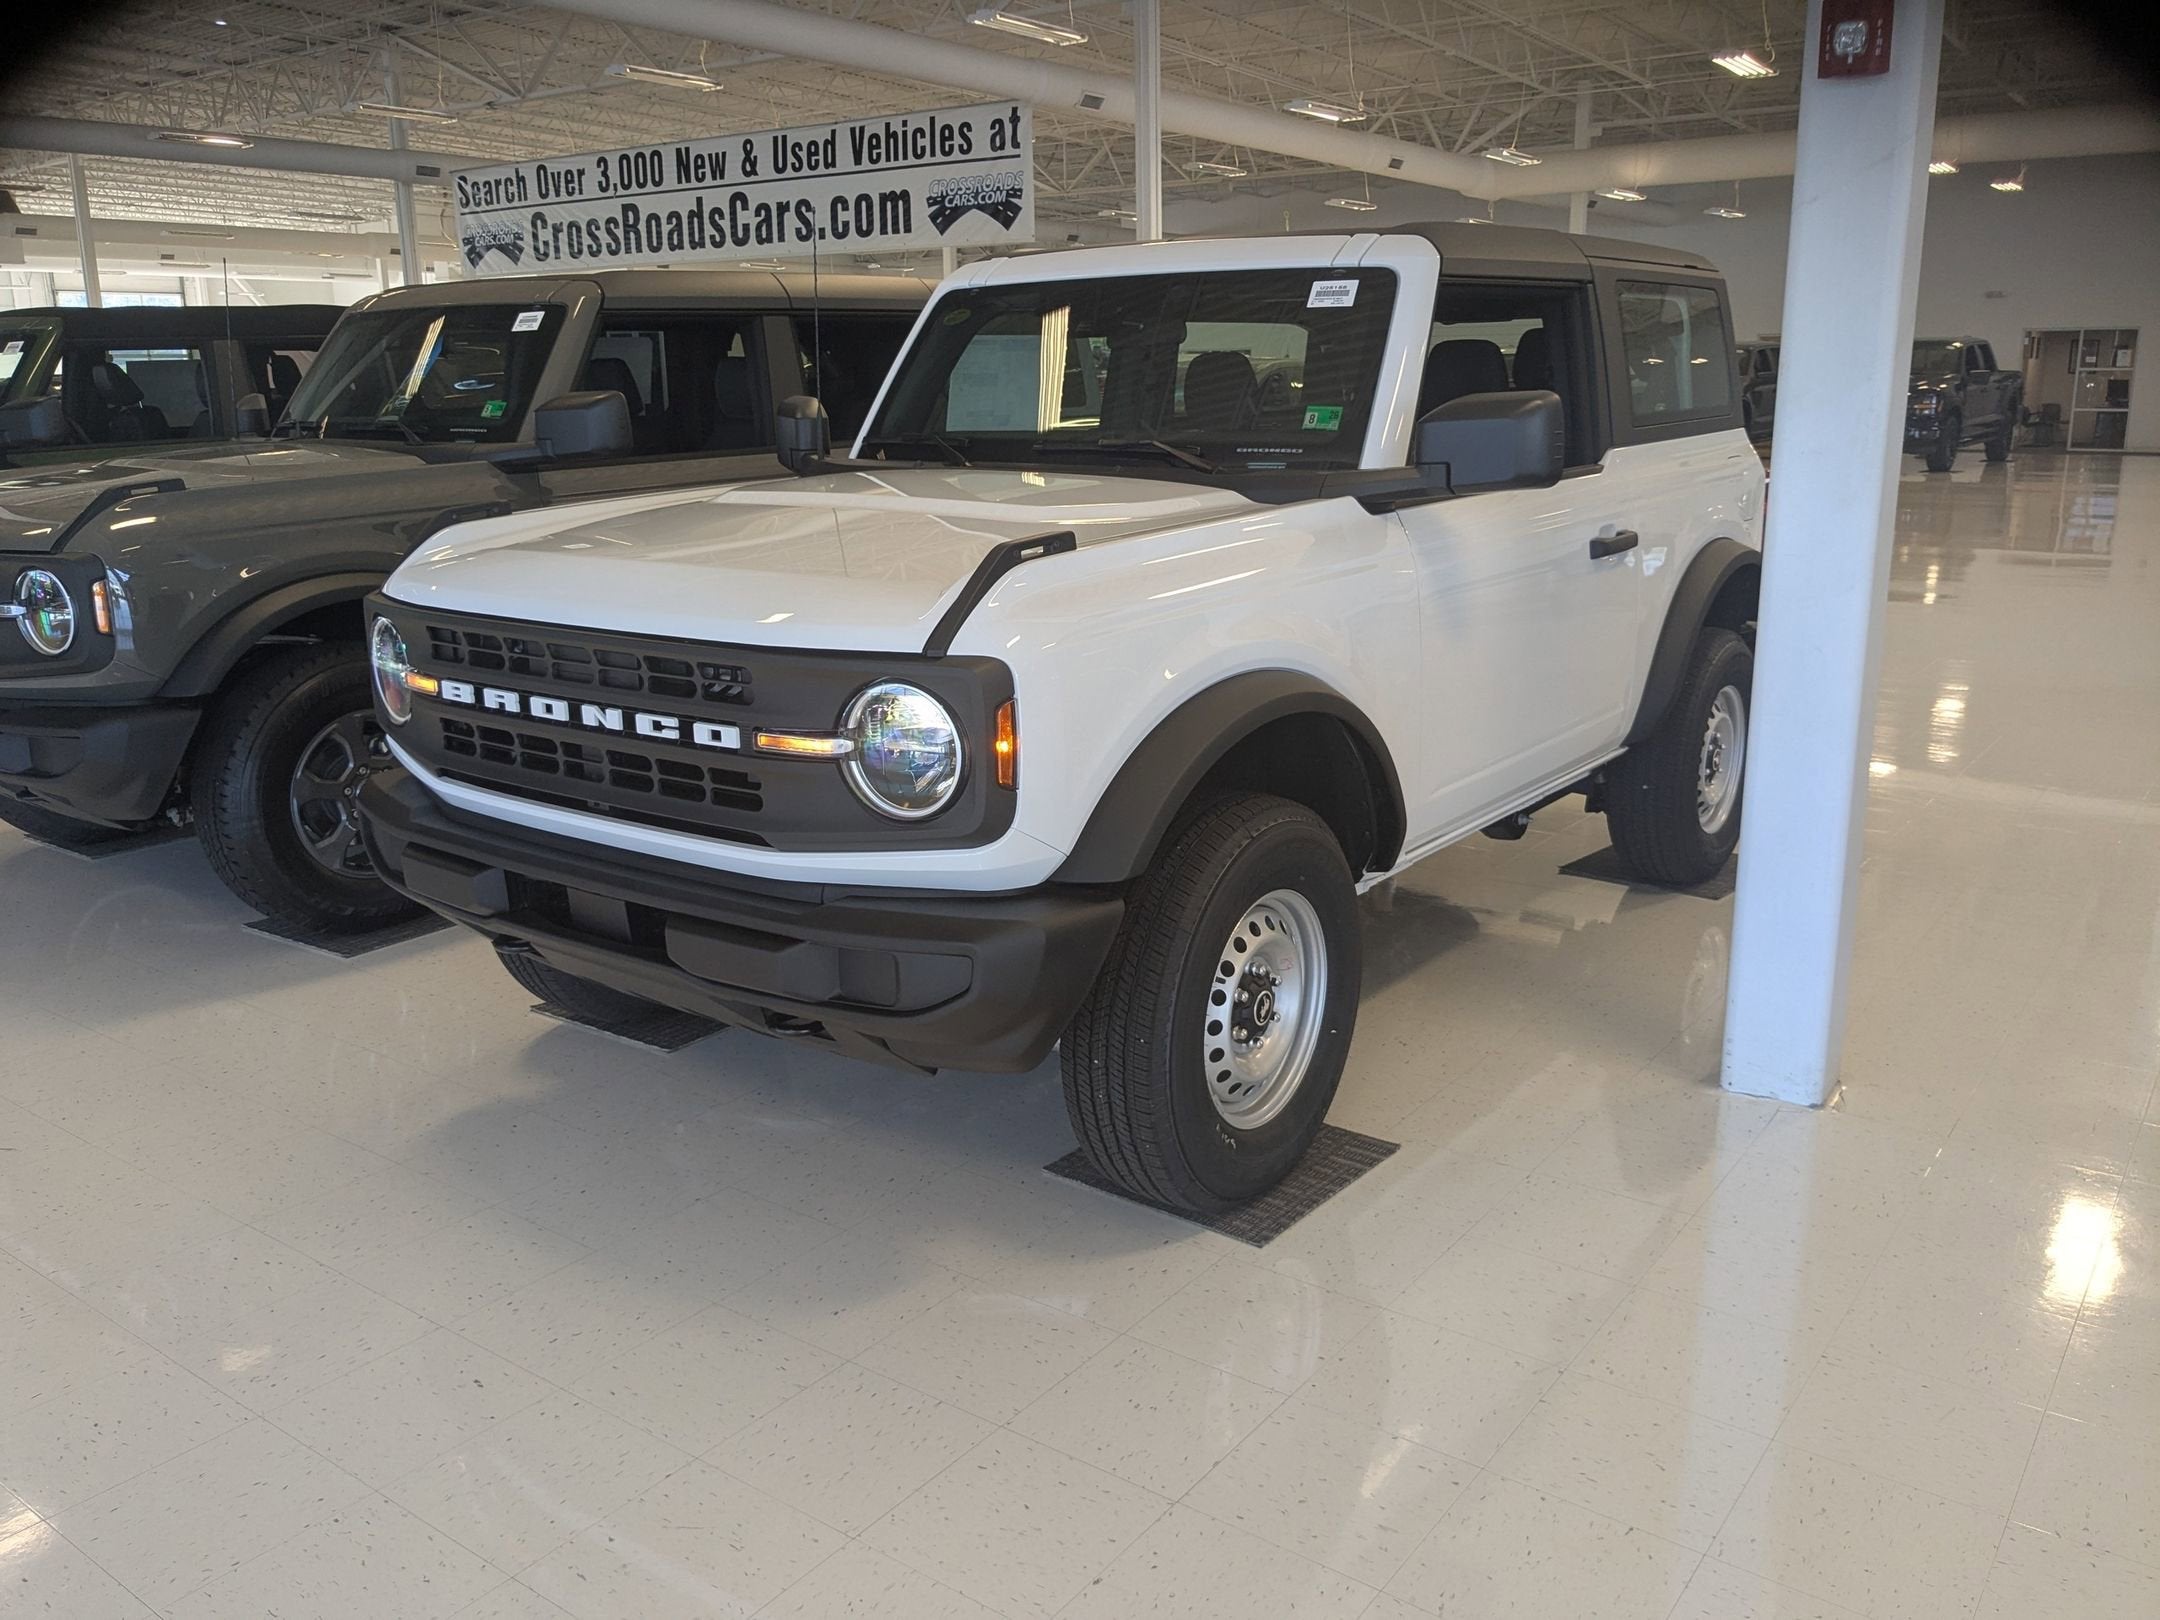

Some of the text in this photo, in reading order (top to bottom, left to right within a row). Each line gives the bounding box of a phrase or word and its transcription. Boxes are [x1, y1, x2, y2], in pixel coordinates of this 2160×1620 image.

[457, 106, 1021, 209] Search Over 3,000 New & Used Vehicles at
[928, 170, 1025, 197] CROSSROADS
[944, 190, 1007, 208] CARS.COM
[530, 188, 912, 262] CrossRoadsCars.com
[1308, 413, 1316, 425] 8
[441, 679, 741, 749] BRONCO
